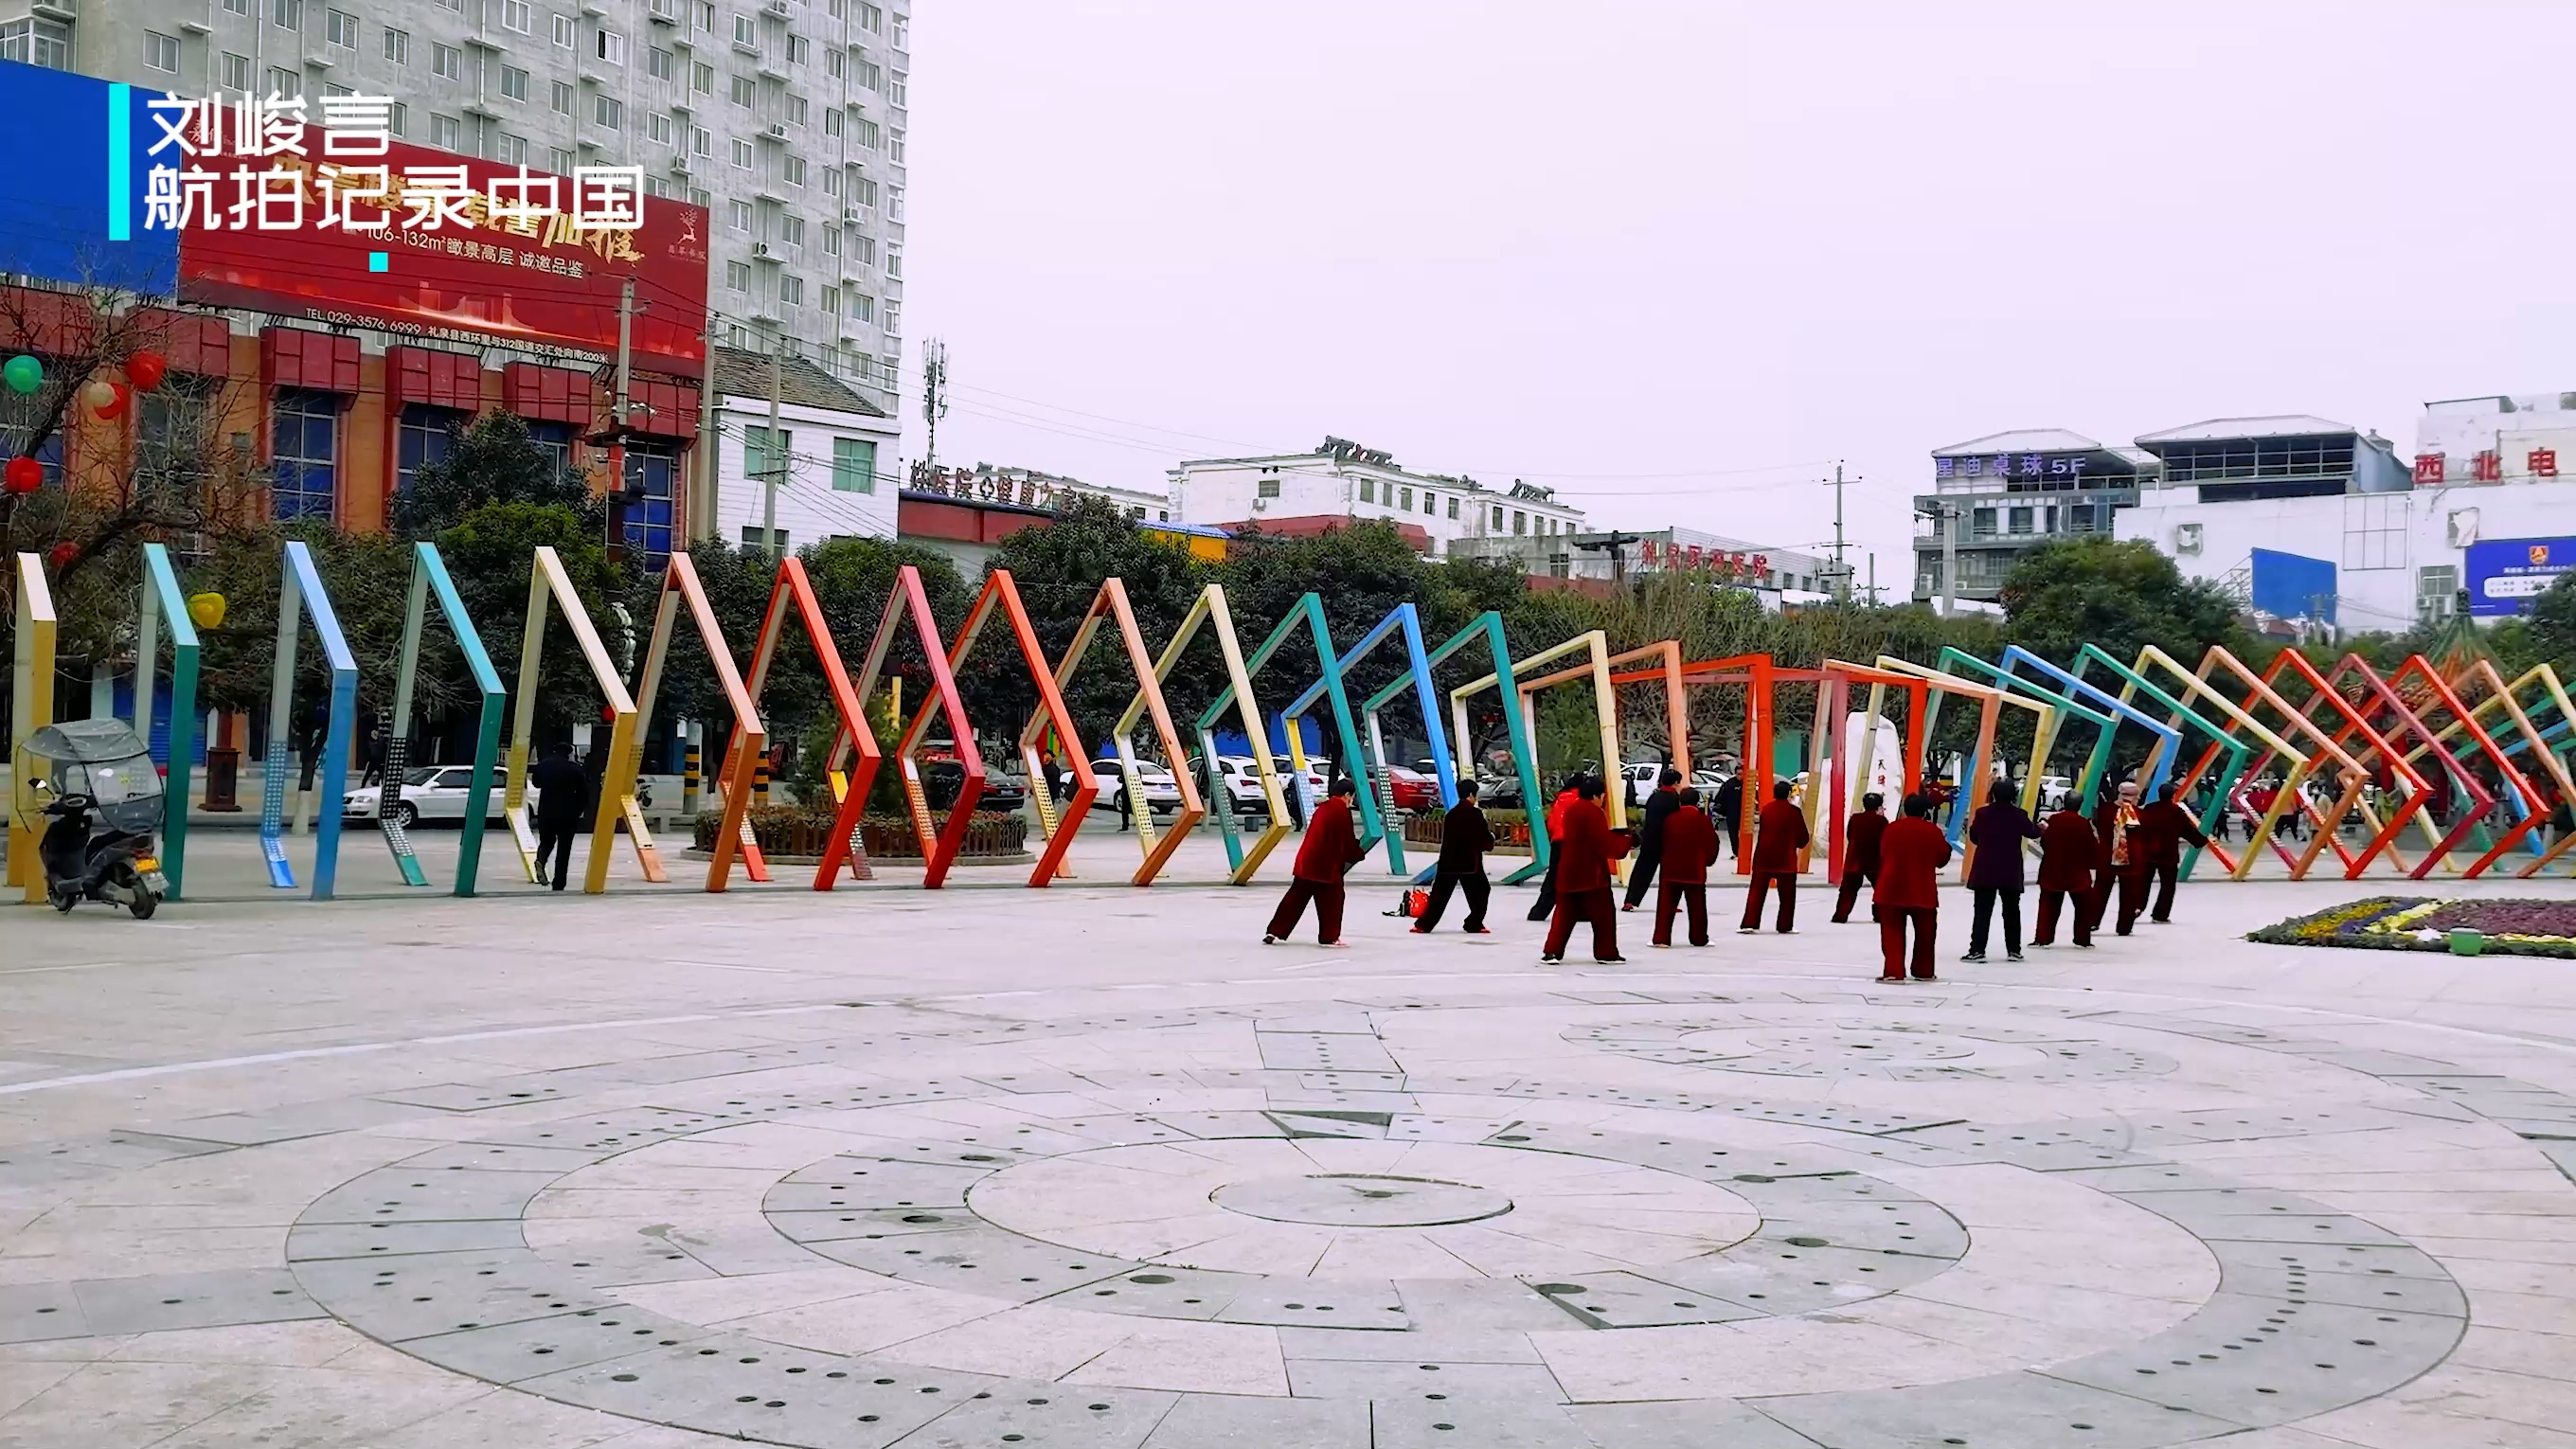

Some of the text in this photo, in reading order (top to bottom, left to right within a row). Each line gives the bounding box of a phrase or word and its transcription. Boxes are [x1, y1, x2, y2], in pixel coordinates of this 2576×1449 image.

[519, 251, 584, 279] 诚邀品鉴
[327, 311, 385, 331] 029-3576
[389, 321, 422, 336] 6999
[2051, 456, 2086, 474] 5F
[2414, 447, 2560, 484] 西北电
